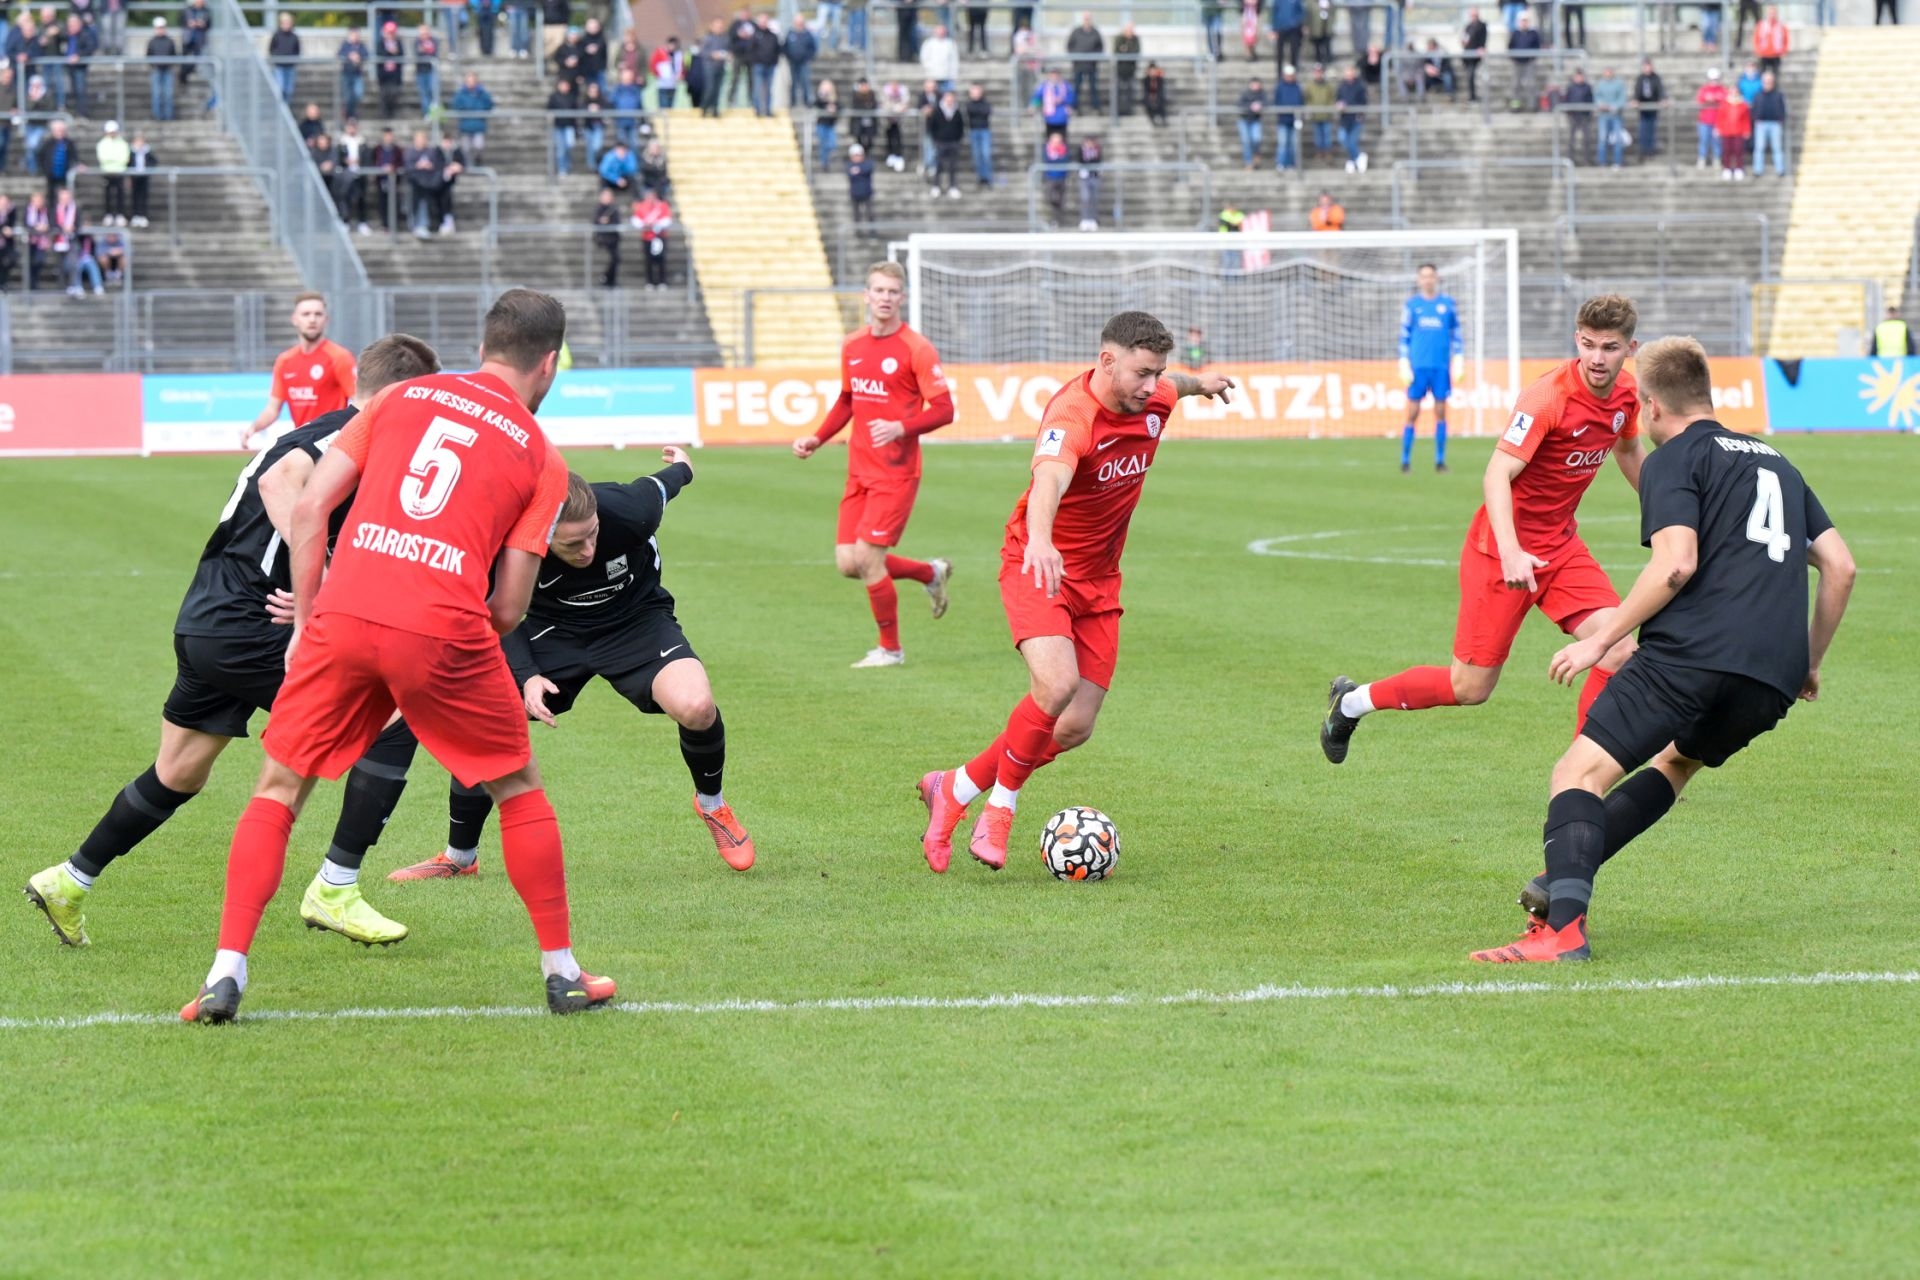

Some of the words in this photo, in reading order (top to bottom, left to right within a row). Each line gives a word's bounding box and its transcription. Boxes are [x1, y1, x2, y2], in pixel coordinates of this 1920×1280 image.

[850, 377, 889, 396] OKAL
[973, 375, 1065, 422] VO
[1182, 373, 1345, 421] LATZ!
[403, 386, 433, 400] KSV
[430, 389, 485, 419] HESSEN
[482, 409, 530, 448] KASSEL
[399, 415, 479, 520] 5
[1097, 453, 1152, 482] OKAL
[1745, 466, 1791, 563] 4
[352, 522, 467, 576] STAROSTZIK
